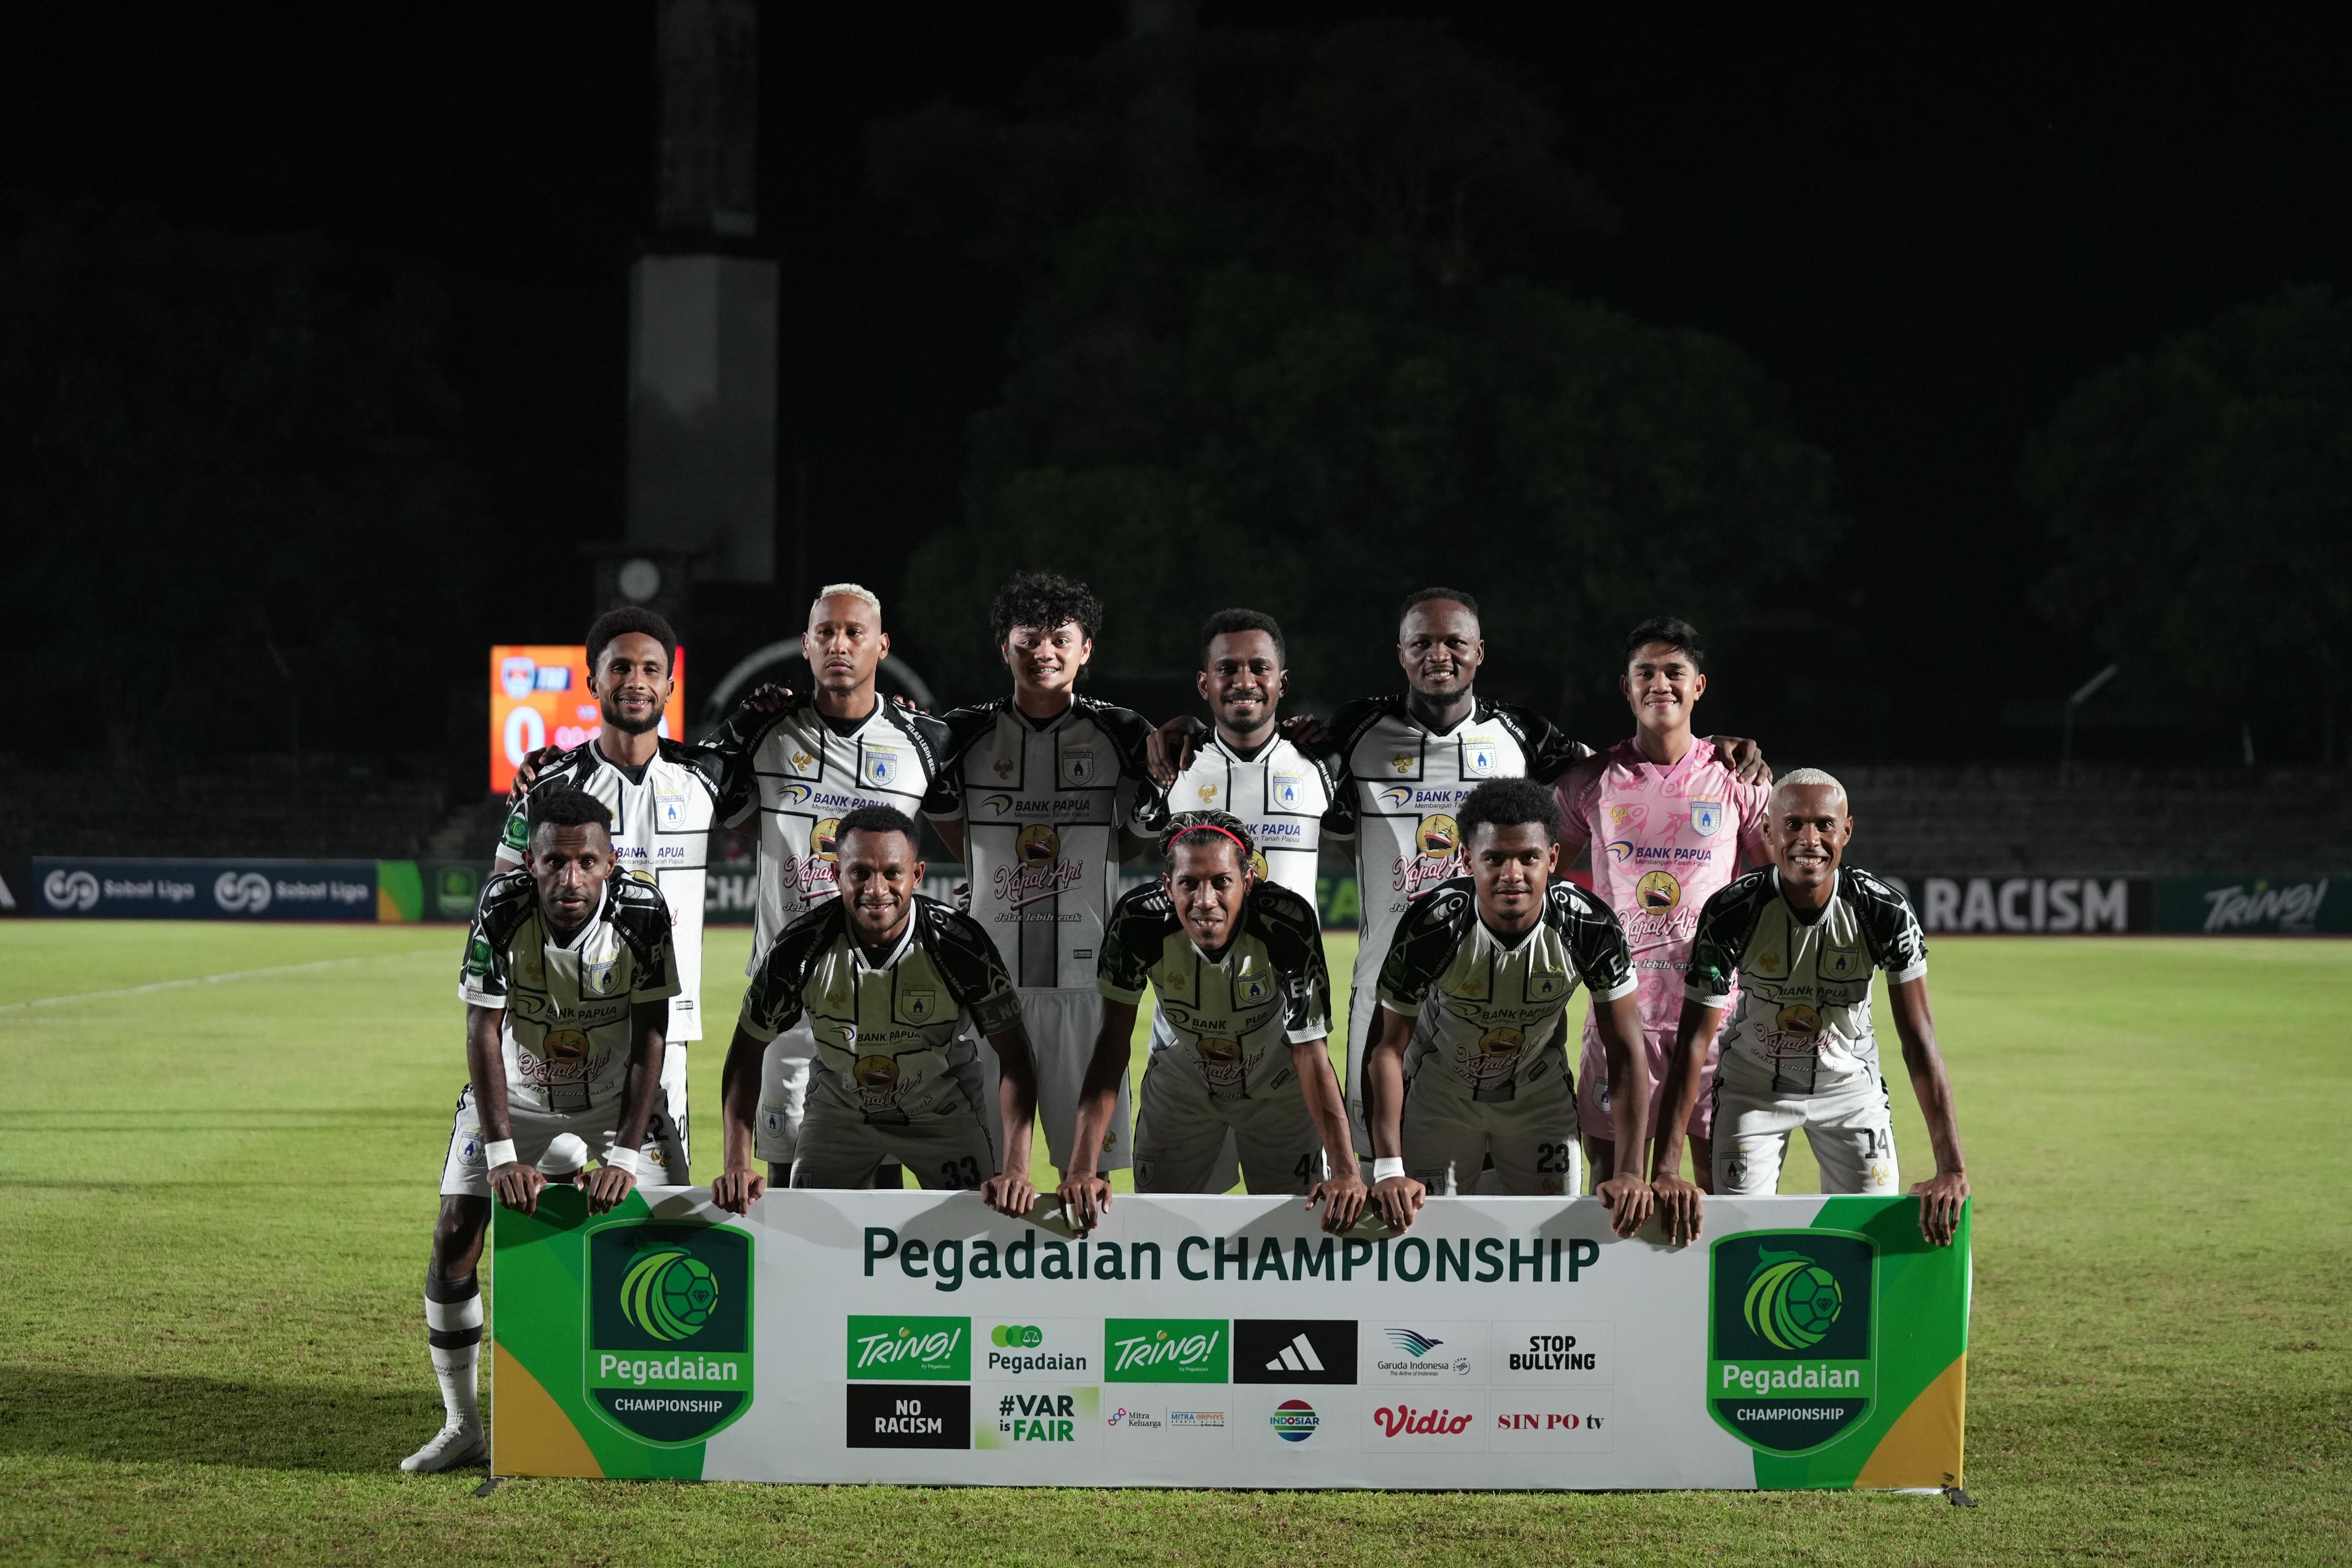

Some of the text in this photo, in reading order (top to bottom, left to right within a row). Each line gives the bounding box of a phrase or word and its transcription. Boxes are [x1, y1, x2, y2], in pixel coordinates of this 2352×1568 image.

[905, 723, 922, 742] JELAS
[918, 738, 932, 759] LEBIH
[814, 793, 848, 808] BANK
[1416, 791, 1451, 802] BANK
[811, 804, 848, 814] Membangun
[1015, 800, 1089, 812] BANK PAPUA
[1261, 824, 1300, 836] PAPUA
[619, 847, 684, 858] BANK APUA
[1636, 847, 1711, 860] BANK PAPUA
[994, 862, 1046, 902] Kapal
[1048, 858, 1083, 888] Api
[1393, 854, 1446, 893] Kapal
[158, 879, 195, 902] Liga
[331, 881, 369, 903] Liga
[1923, 878, 2129, 932] RACISM
[995, 913, 1082, 922] Jelas lebih enak
[1618, 908, 1667, 948] Kapal
[1641, 959, 1671, 969] lebih
[1779, 985, 1814, 997] BANK
[578, 1006, 617, 1020] PAPUA
[1482, 1008, 1517, 1020] BANK
[1192, 1018, 1227, 1030] BANK
[857, 1030, 921, 1042] BANK PAPUA
[1754, 1021, 1808, 1054] Kapal
[1454, 1043, 1512, 1073] Kapal
[520, 1052, 578, 1084] Kapal
[1864, 1128, 1891, 1159] 14
[1537, 1142, 1571, 1175] 23
[941, 1155, 982, 1189] 33
[864, 1227, 1599, 1292] Pegadaian CHAMPIONSHIP
[1529, 1335, 1576, 1353] STOP
[600, 1354, 737, 1385] Pegadaian
[989, 1353, 1087, 1374] Pegadaian
[1378, 1361, 1449, 1370] Garuda Indonesia
[1510, 1354, 1596, 1370] BULLYING
[1723, 1364, 1860, 1394] Pegadaian
[615, 1398, 723, 1413] CHAMPIONSHIP
[896, 1400, 922, 1415] NO
[1000, 1394, 1075, 1417] #VAR
[1270, 1417, 1320, 1426] INDOSIAR
[1374, 1405, 1473, 1437] Vidio
[1498, 1414, 1605, 1430] SIN PO tv
[1737, 1408, 1844, 1421] CHAMPIONSHIP
[875, 1418, 942, 1434] RACISM
[1000, 1419, 1075, 1441] is FAIR
[1129, 1419, 1161, 1428] Keluarga
